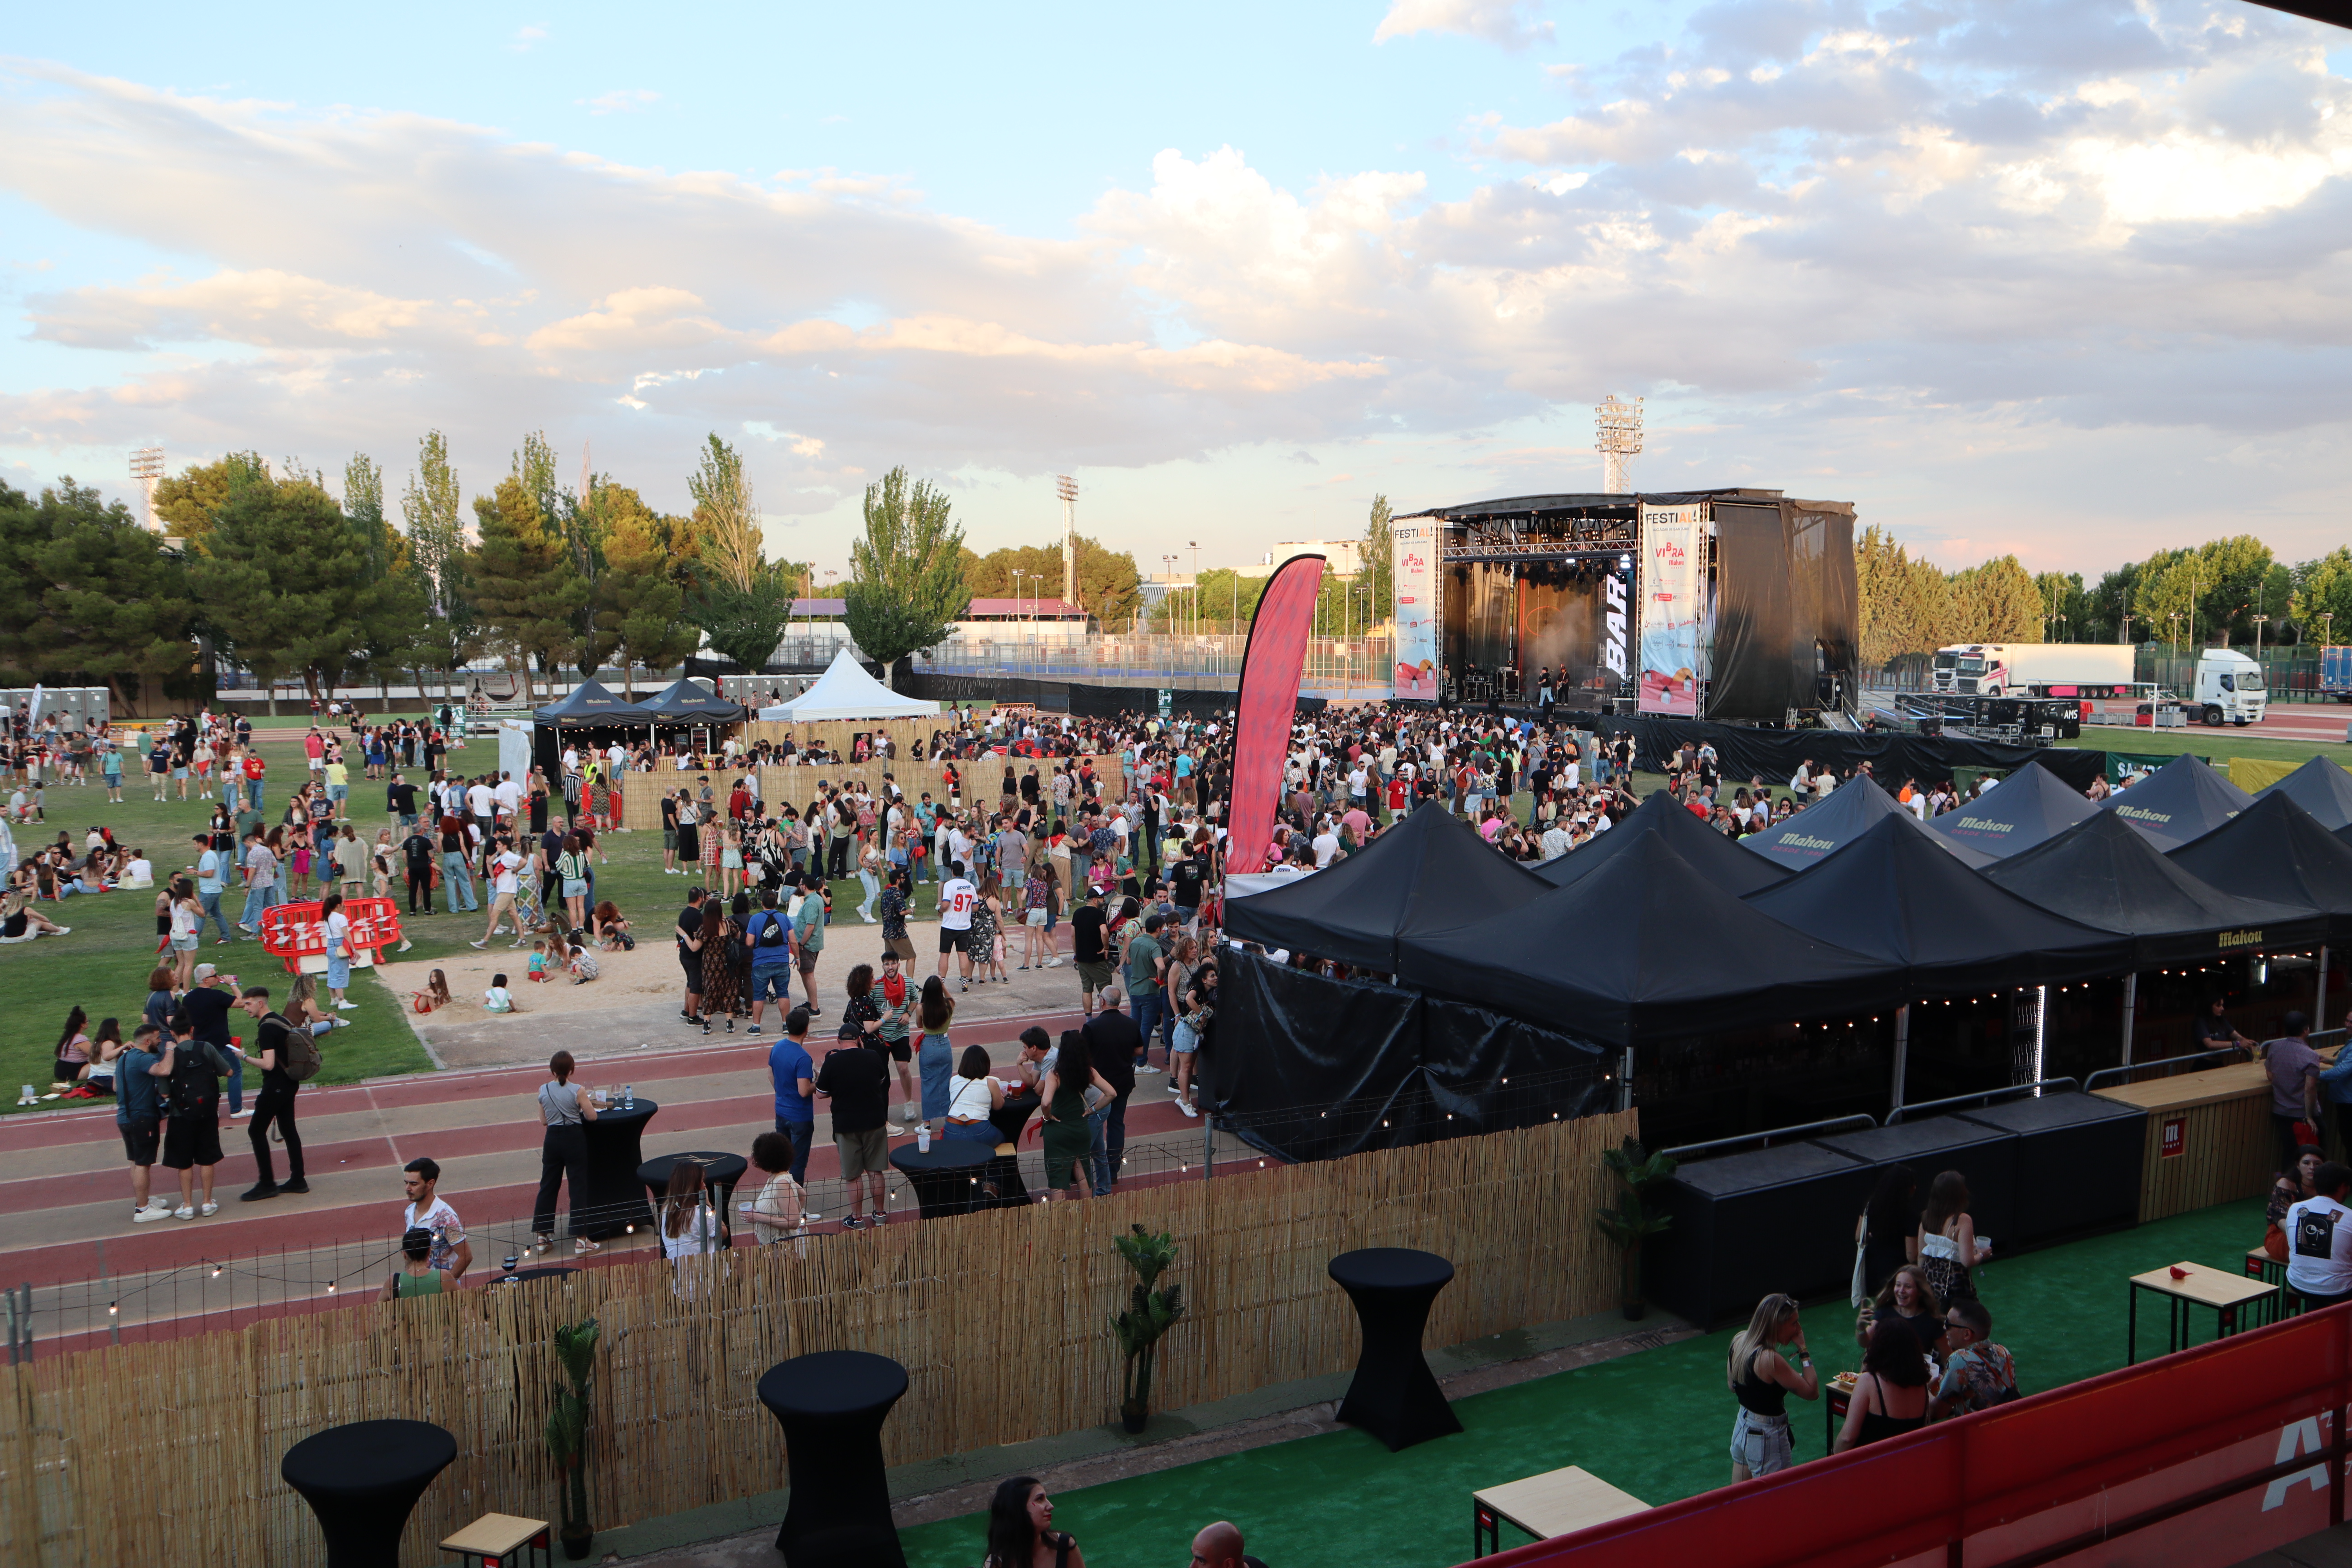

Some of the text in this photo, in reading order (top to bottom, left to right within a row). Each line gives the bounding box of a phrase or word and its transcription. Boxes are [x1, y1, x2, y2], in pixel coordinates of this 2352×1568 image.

[1646, 510, 1697, 524] FESTIAL!
[1395, 526, 1433, 539] FESTIAL!
[1655, 542, 1684, 558] VIBRA
[1402, 554, 1424, 567] VIBRA
[2064, 709, 2078, 720] AMS
[2116, 805, 2172, 822] Mahou
[1957, 817, 2014, 833] Mahou
[1950, 829, 1981, 837] DESDE
[1778, 832, 1835, 850] Mahou
[1770, 846, 1801, 854] DESDE
[954, 893, 973, 912] 97
[2219, 929, 2263, 948] Mahou
